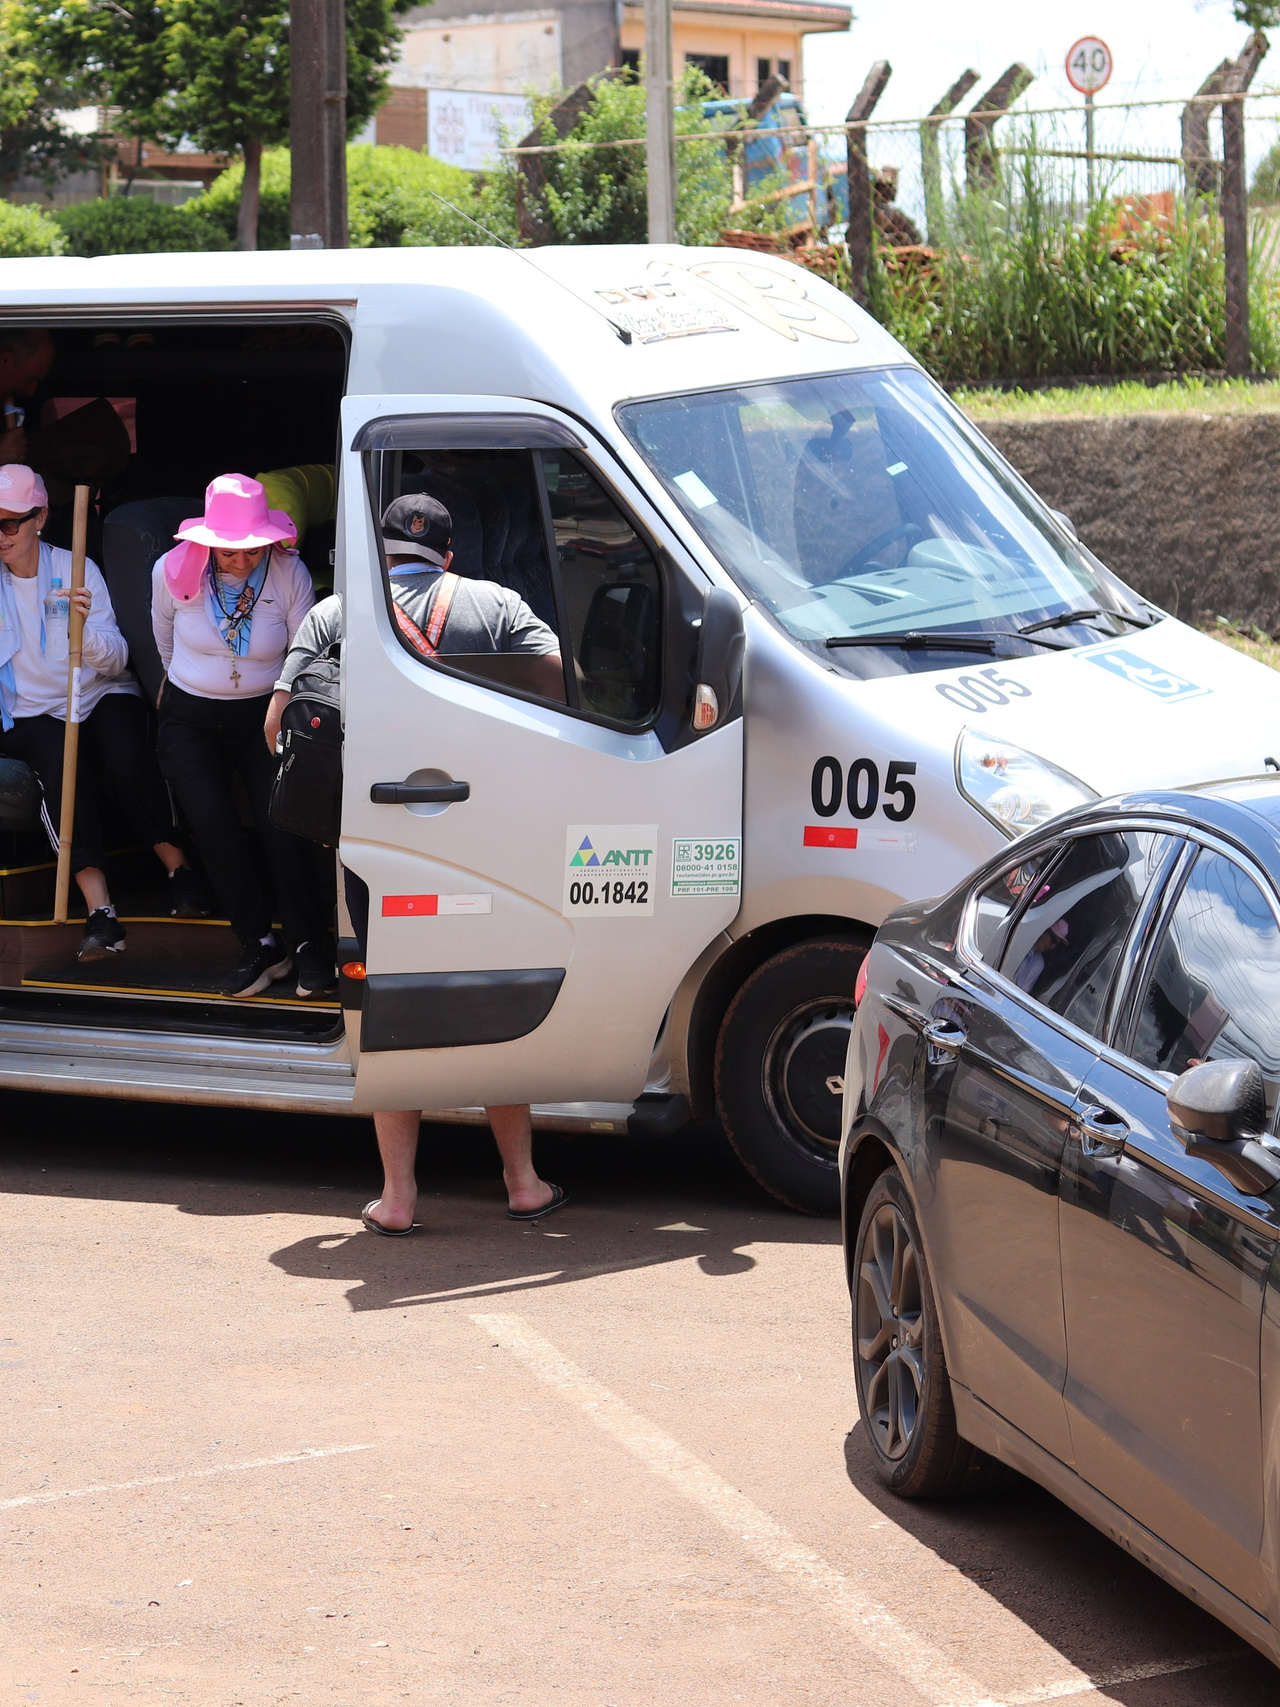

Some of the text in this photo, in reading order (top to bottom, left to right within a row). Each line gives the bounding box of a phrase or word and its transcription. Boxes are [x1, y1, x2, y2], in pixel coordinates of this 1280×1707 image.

[1073, 48, 1106, 72] 40
[934, 668, 1033, 713] 005
[811, 756, 918, 822] 005
[601, 850, 653, 866] ANTT
[694, 844, 736, 861] 3926
[717, 863, 738, 871] 0158
[570, 881, 649, 905] 00.1842
